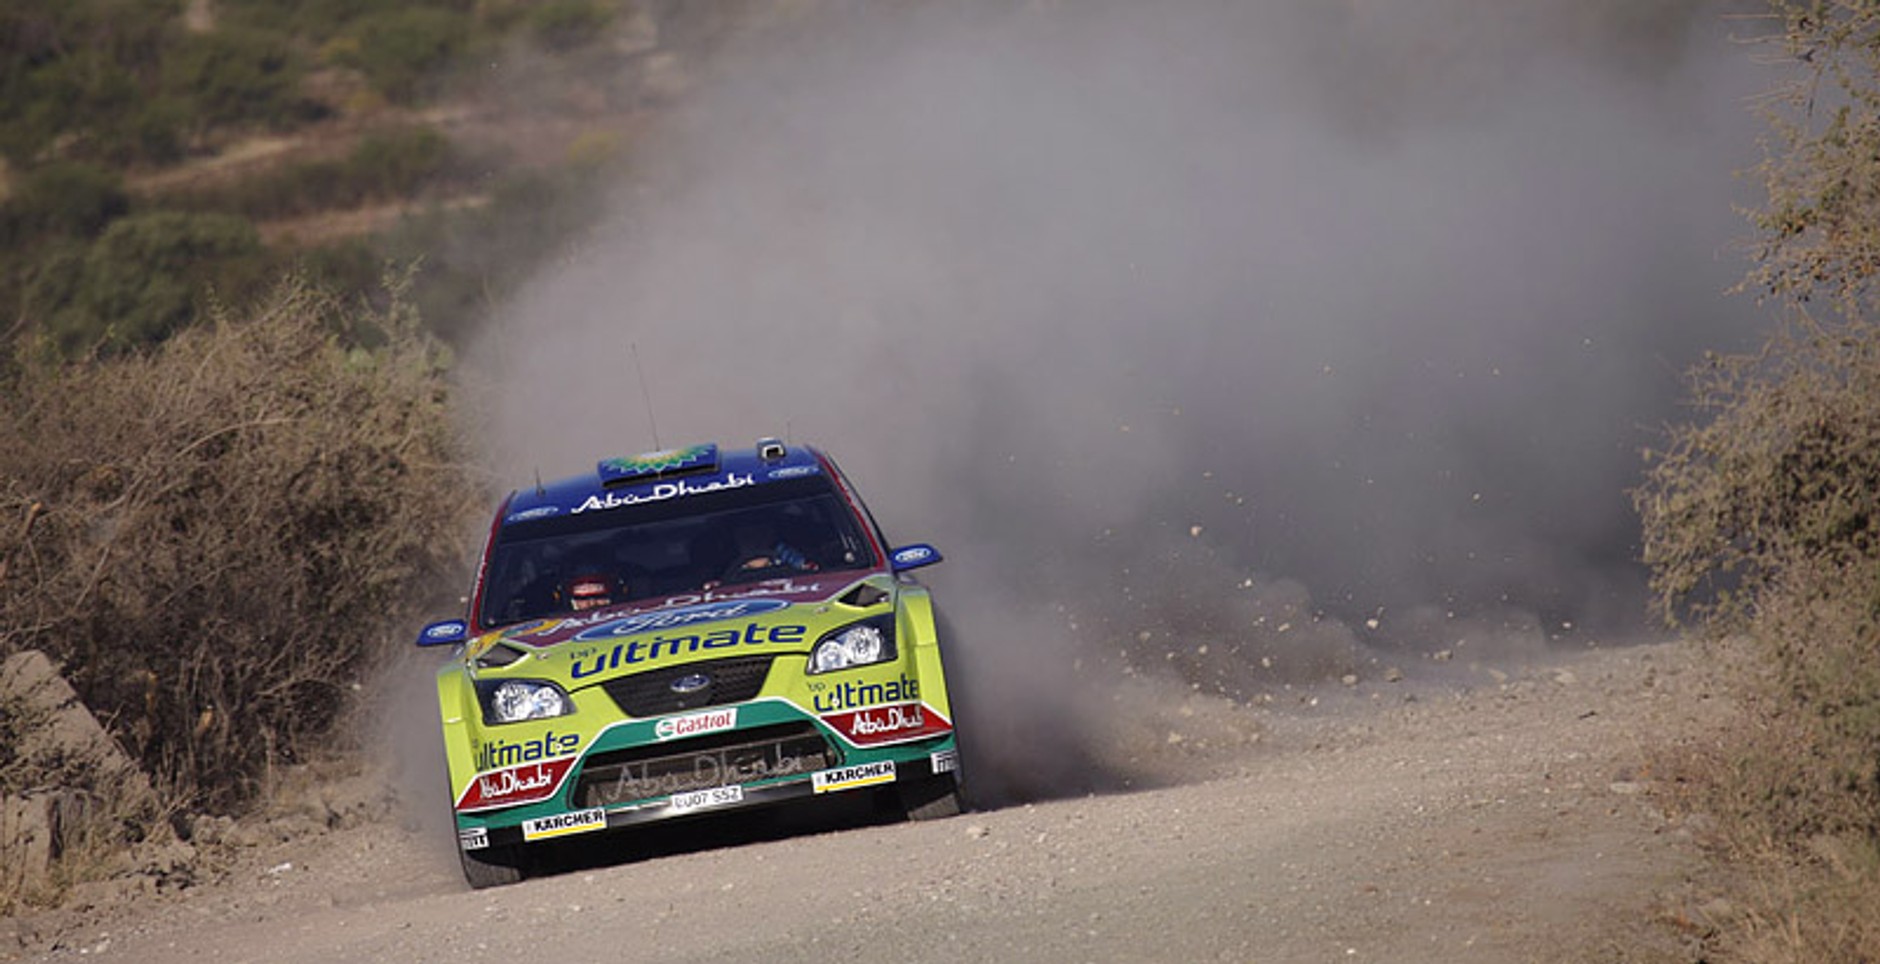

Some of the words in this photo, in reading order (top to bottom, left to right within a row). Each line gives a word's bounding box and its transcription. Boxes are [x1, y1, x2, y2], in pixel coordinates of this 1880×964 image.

[612, 603, 748, 633] Ford
[571, 623, 807, 679] ultimate
[813, 673, 920, 712] ultimate
[676, 712, 732, 735] Castrol
[476, 731, 580, 772] ultimate
